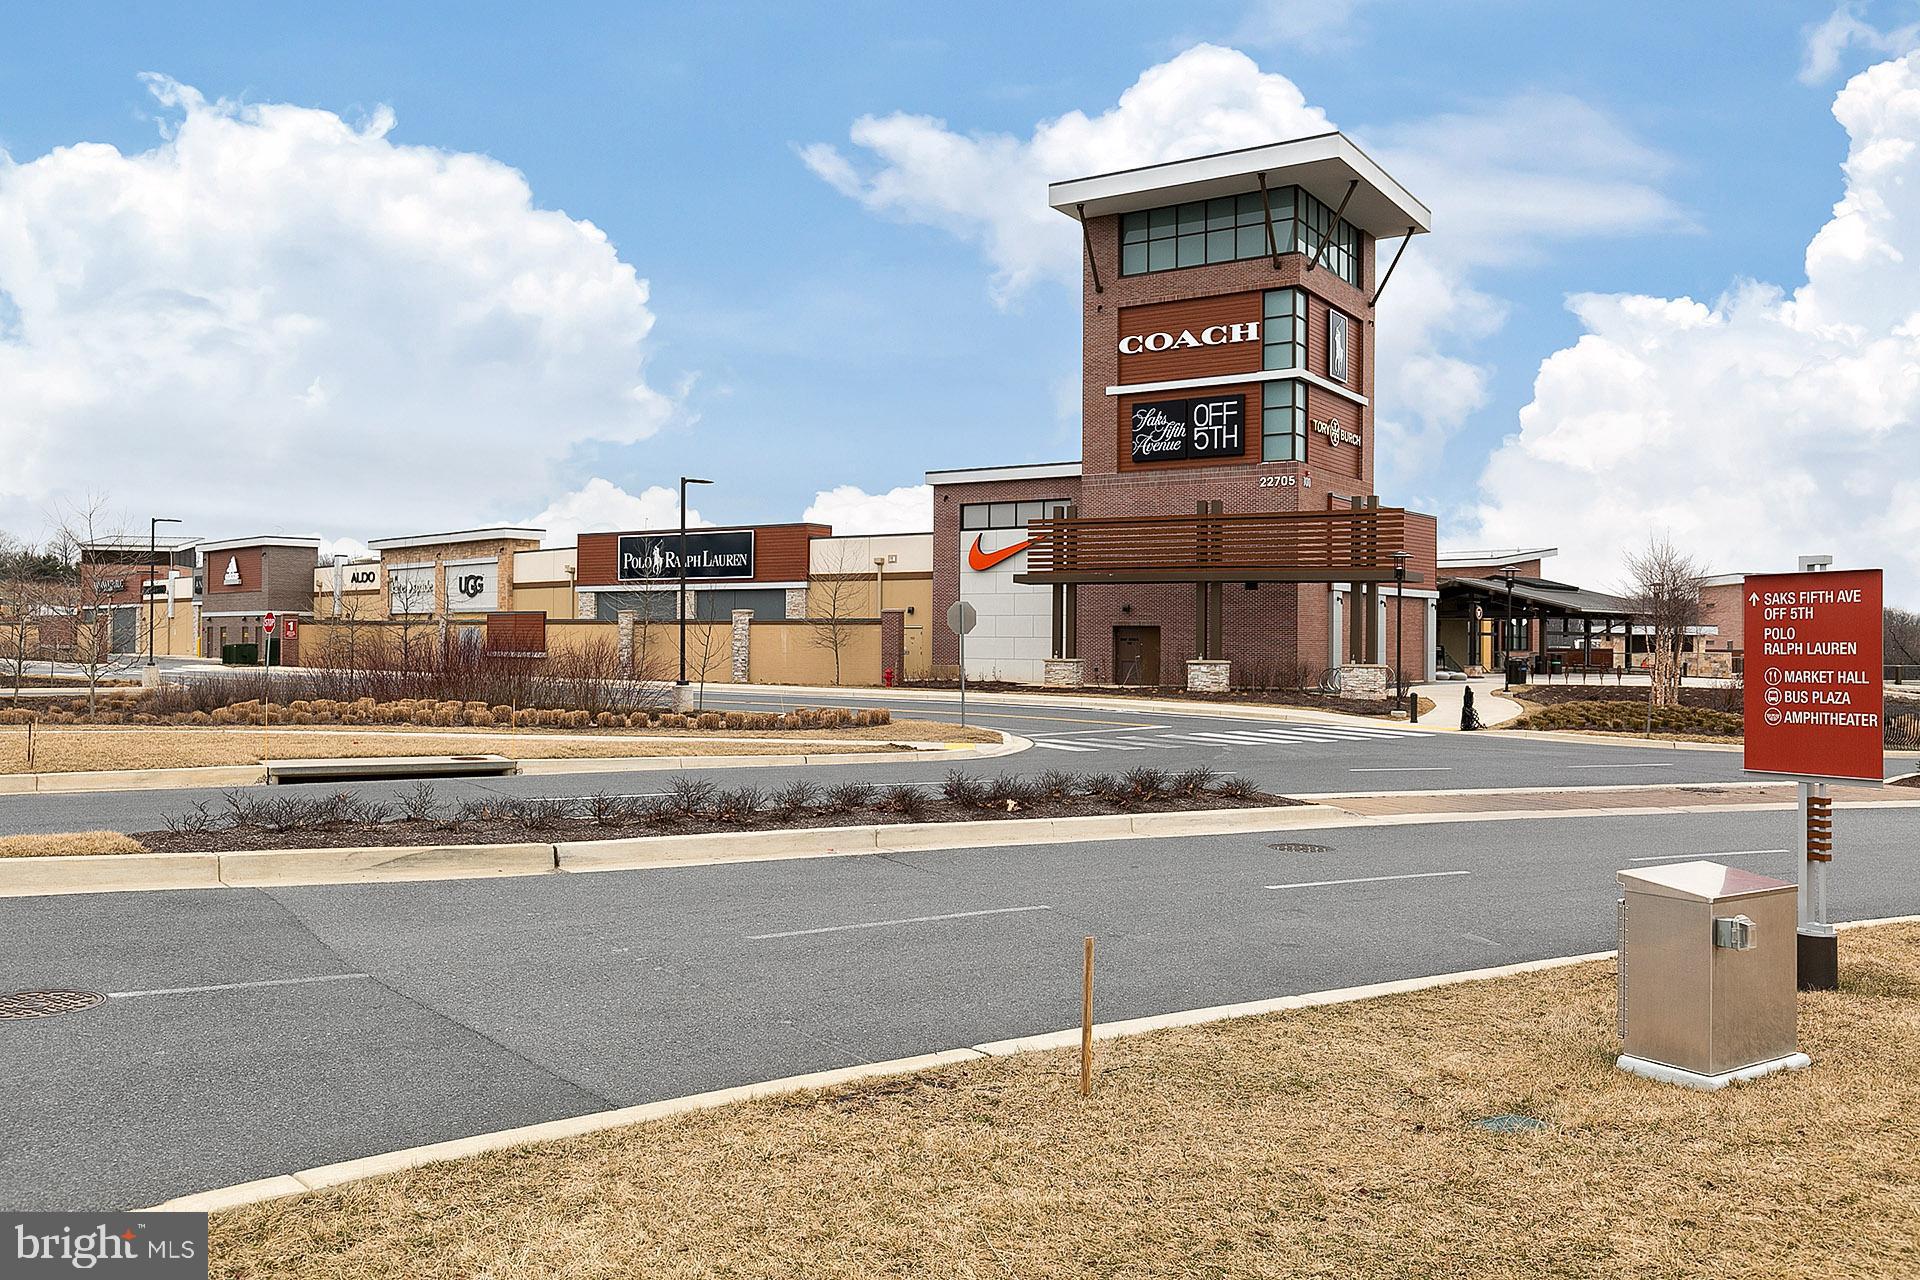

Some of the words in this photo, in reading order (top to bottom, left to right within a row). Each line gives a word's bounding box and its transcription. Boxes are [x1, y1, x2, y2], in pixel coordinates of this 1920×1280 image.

[1118, 321, 1260, 354] COACH
[1193, 401, 1238, 427] OFF
[1194, 424, 1238, 450] 5TH
[1313, 419, 1331, 436] TORY
[1340, 429, 1361, 447] BURCH
[1132, 434, 1182, 456] Avenue
[1259, 475, 1296, 487] 22705
[665, 551, 701, 568] RAPH
[350, 571, 376, 583] ALDO
[458, 574, 484, 598] UGG
[1764, 592, 1796, 606] SAKS
[1799, 590, 1834, 605] FIFTH
[1837, 589, 1862, 603] AVE
[1764, 607, 1787, 621] OFF
[1790, 606, 1814, 620] 5TH
[287, 621, 294, 631] 1
[1764, 627, 1796, 640] POLO
[1764, 642, 1803, 656] RALPH
[1806, 641, 1857, 655] LAUREN
[1784, 671, 1834, 684] MARKET
[1837, 671, 1870, 685] HALL
[1784, 691, 1809, 704] BUS
[1812, 691, 1851, 705] PLAZA
[1784, 711, 1878, 728] AMPHITHEATER
